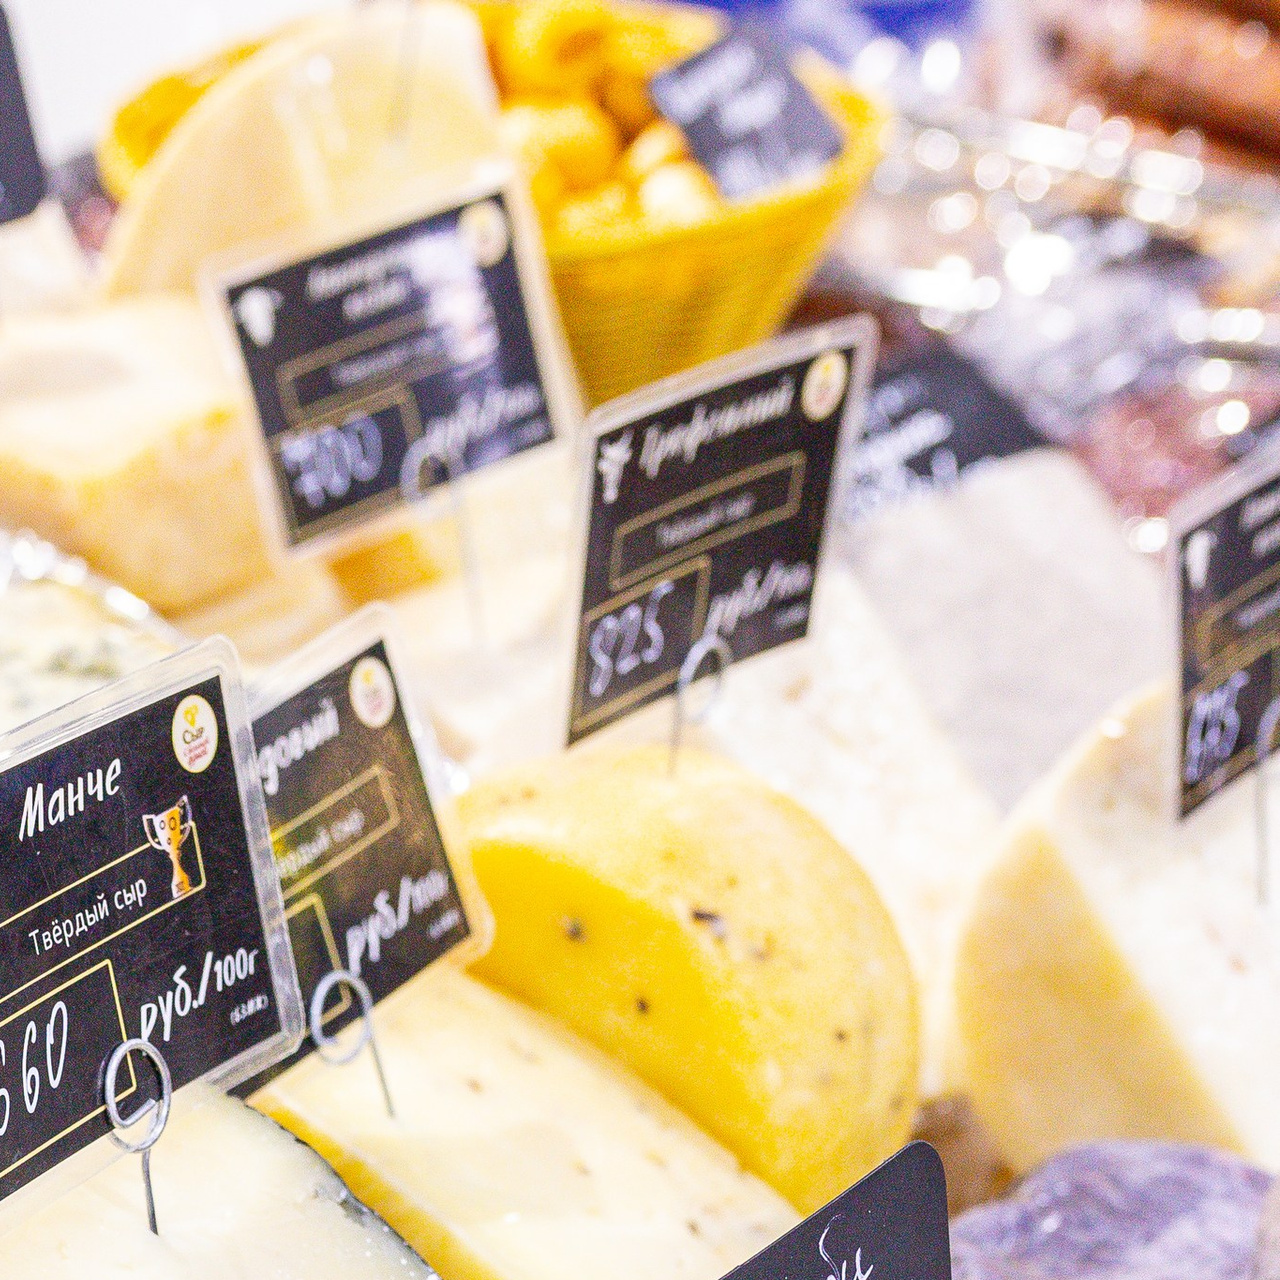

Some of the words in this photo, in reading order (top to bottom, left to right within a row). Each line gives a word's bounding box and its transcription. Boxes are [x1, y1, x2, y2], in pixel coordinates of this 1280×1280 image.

[19, 757, 122, 842] Манче
[27, 893, 111, 957] Твёрдый
[113, 875, 148, 916] сыр
[140, 946, 260, 1056] руб./100г
